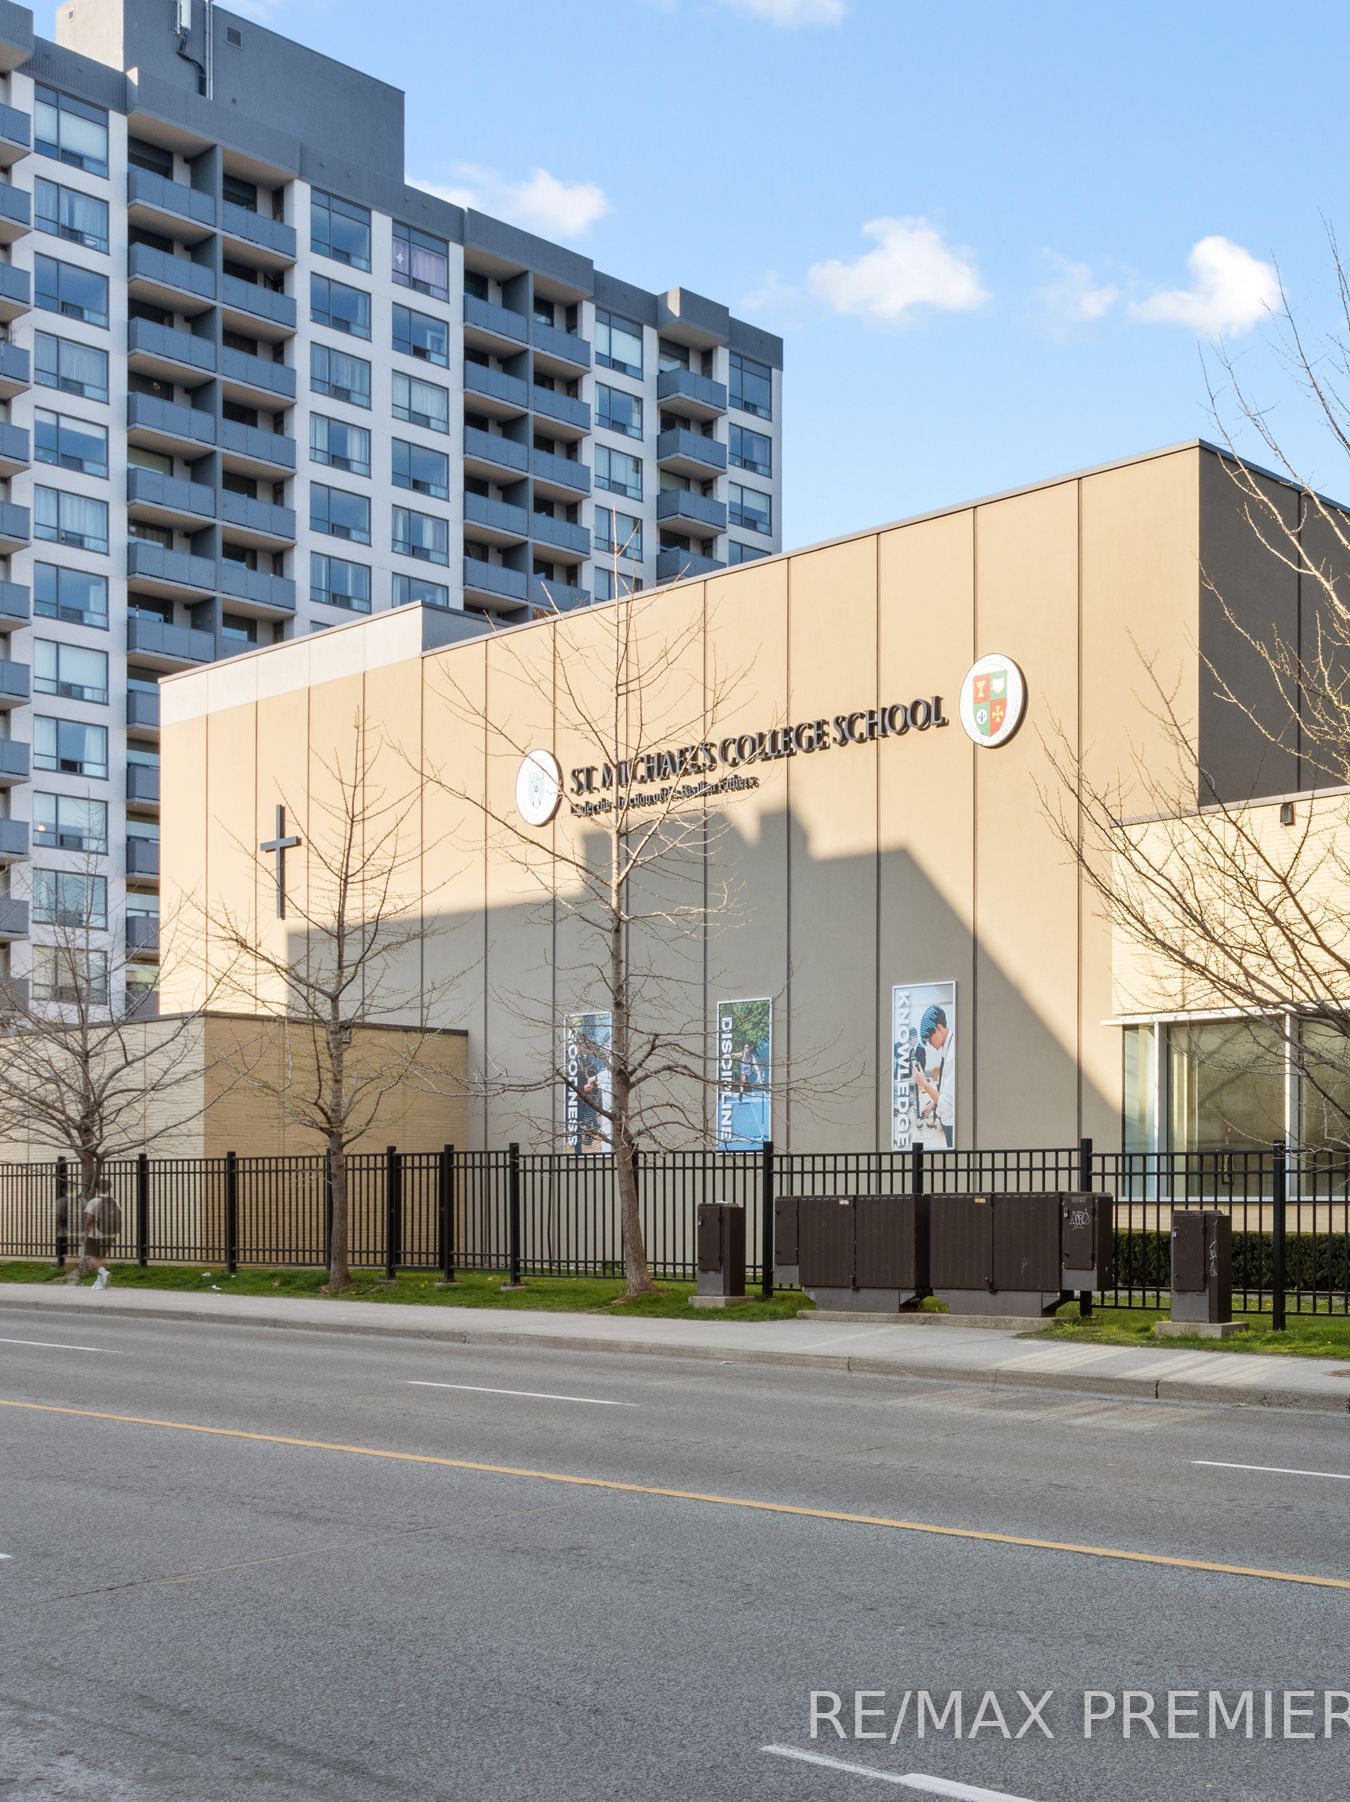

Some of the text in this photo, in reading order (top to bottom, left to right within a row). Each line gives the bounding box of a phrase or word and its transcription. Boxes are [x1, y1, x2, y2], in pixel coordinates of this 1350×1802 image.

[718, 719, 831, 767] COLLEGE
[833, 695, 949, 748] SCHOOL
[613, 791, 655, 811] irction
[897, 991, 911, 1148] KNOWLEDGE
